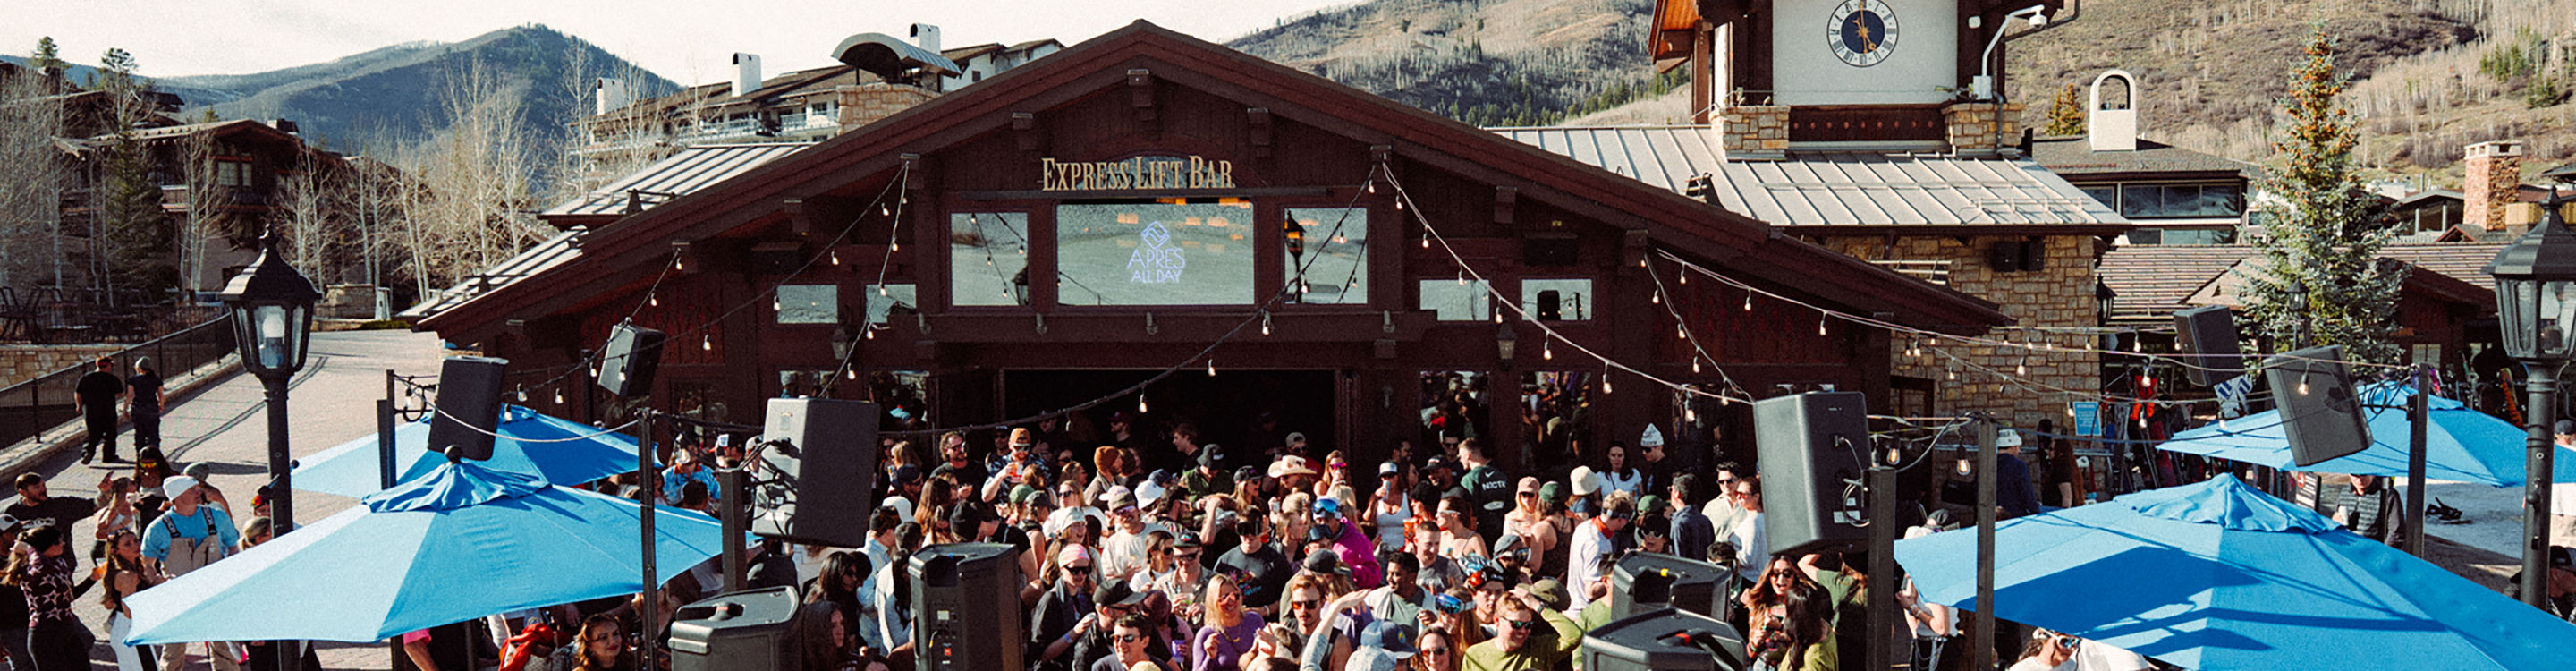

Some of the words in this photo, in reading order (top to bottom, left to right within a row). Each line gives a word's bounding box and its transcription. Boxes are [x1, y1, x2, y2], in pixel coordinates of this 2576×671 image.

[1041, 157, 1130, 191] EXPRESS
[1134, 157, 1184, 190] LIFT
[1188, 155, 1233, 189] BAR
[1126, 248, 1186, 269] APRES
[1131, 269, 1154, 283] ALL
[1157, 269, 1182, 283] DAY
